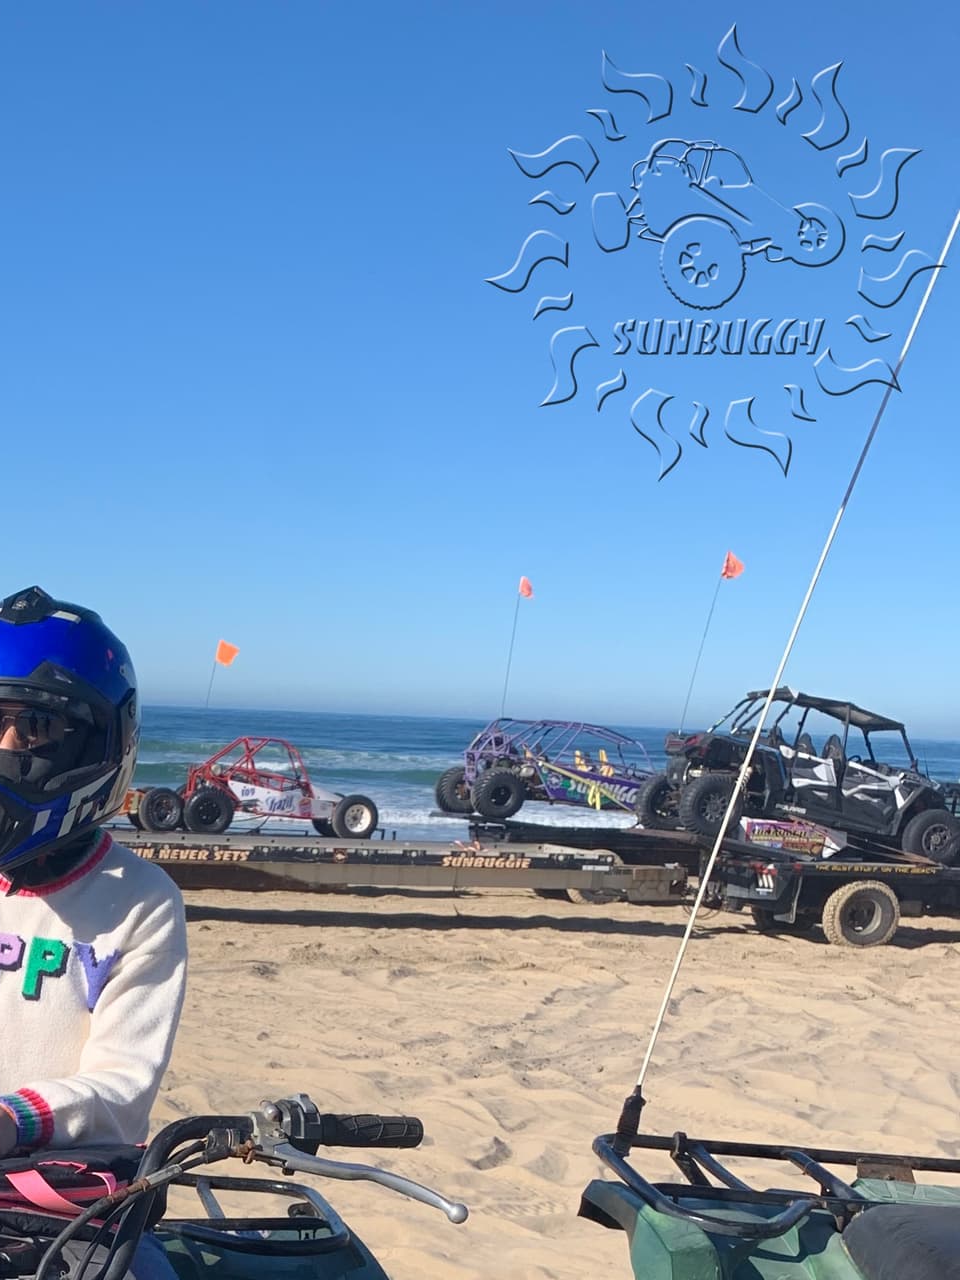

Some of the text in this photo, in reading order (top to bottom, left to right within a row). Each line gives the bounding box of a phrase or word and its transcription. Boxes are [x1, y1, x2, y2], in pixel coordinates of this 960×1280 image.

[157, 847, 209, 861] NEVER
[213, 850, 251, 862] SETS
[441, 855, 532, 869] SUNBUGGIE
